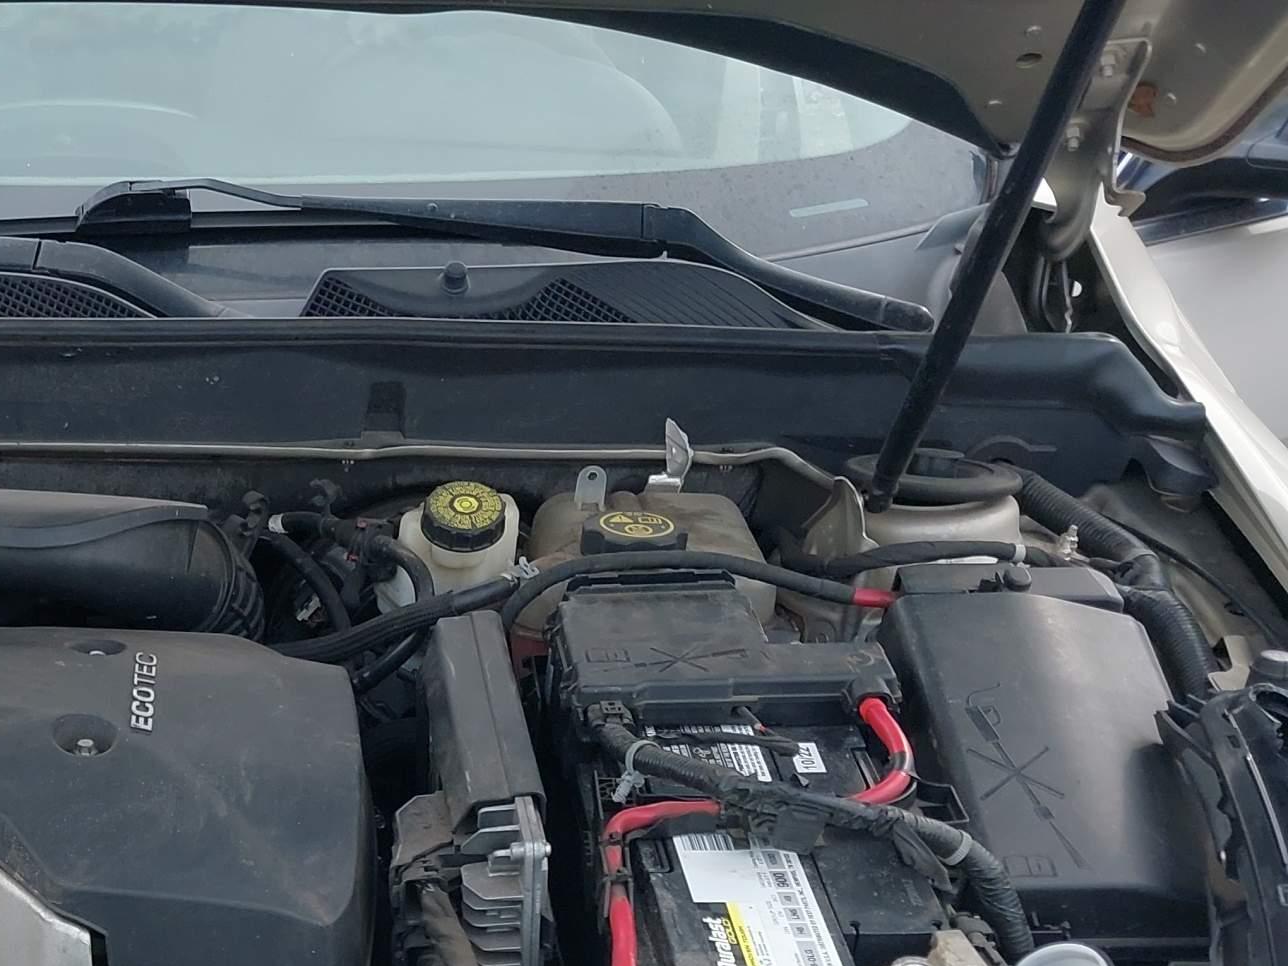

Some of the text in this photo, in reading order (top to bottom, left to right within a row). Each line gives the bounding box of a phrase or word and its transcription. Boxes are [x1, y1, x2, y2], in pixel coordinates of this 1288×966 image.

[130, 652, 157, 731] ECOTEC
[771, 872, 789, 887] 900
[720, 918, 738, 944] GOLD
